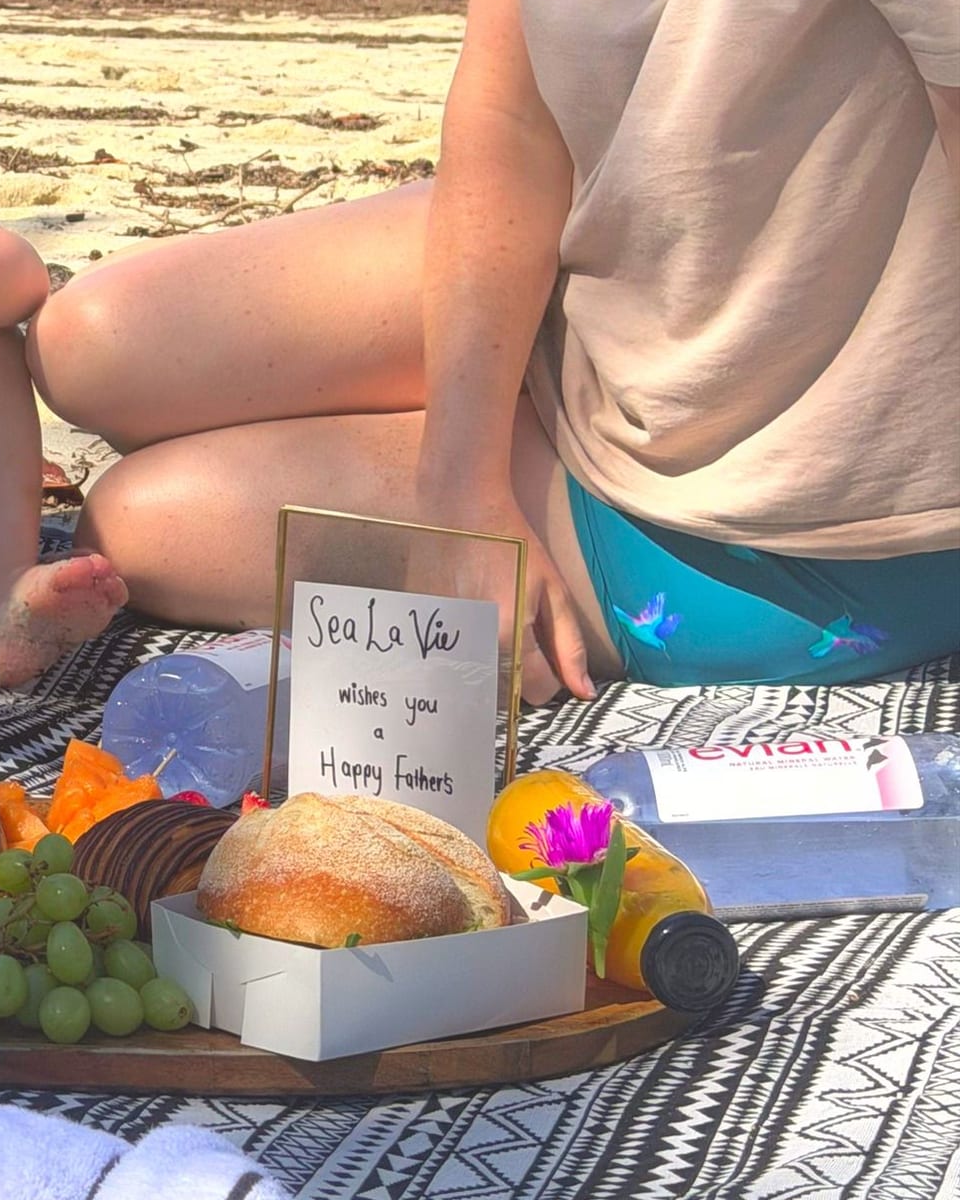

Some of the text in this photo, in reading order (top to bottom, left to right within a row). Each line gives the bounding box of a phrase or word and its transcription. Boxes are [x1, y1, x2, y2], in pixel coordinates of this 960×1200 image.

[308, 595, 357, 647] Sea
[366, 598, 404, 652] La
[409, 608, 460, 659] Vie
[338, 682, 438, 726] wishes you
[373, 727, 385, 740] a
[688, 739, 852, 760] evian
[321, 746, 382, 796] Happy
